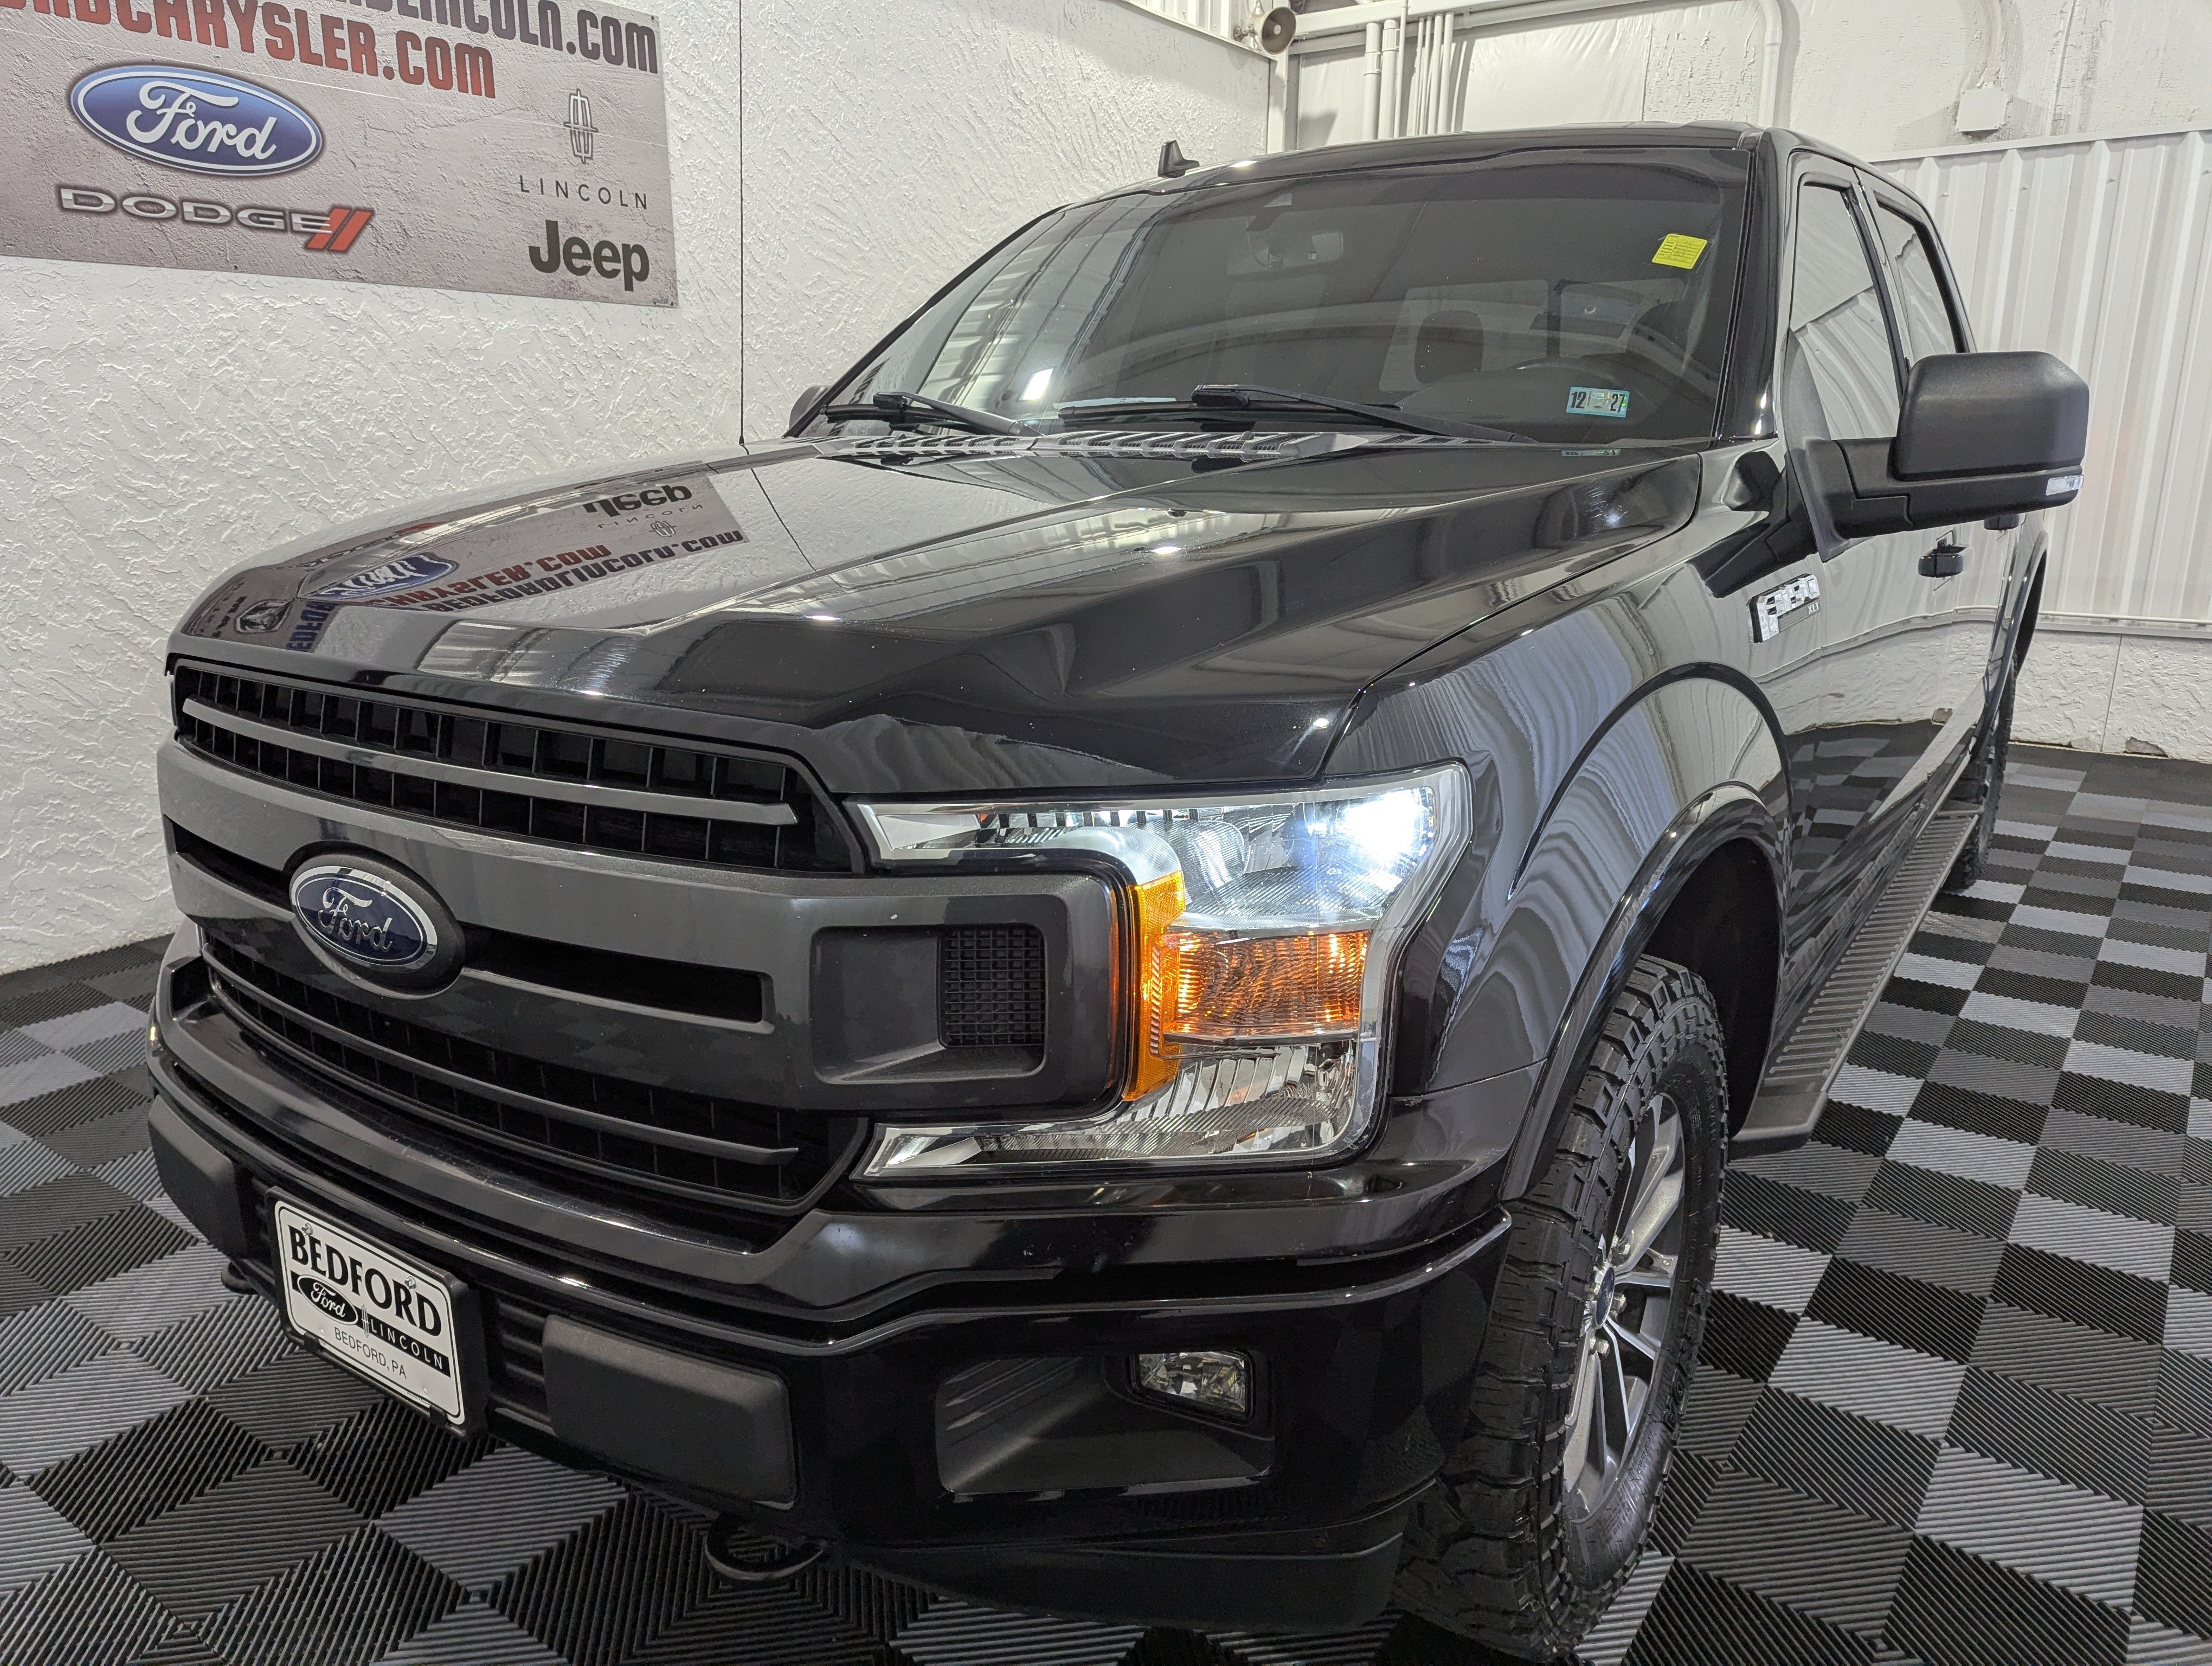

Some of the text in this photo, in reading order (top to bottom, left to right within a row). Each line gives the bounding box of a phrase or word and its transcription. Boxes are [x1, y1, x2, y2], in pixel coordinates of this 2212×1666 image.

[126, 81, 278, 160] Ford
[60, 188, 333, 235] DODGE
[519, 175, 647, 210] LINCOLN
[528, 219, 650, 292] Jeep
[1571, 391, 1587, 409] 12
[1610, 393, 1625, 413] 27
[1807, 601, 1819, 615] XLT
[317, 887, 394, 953] Ford
[287, 1224, 442, 1337] BEDFORD
[310, 1281, 347, 1318] Ford
[334, 1327, 407, 1379] BEDFORD, PA
[370, 1318, 442, 1370] LINCOLN
